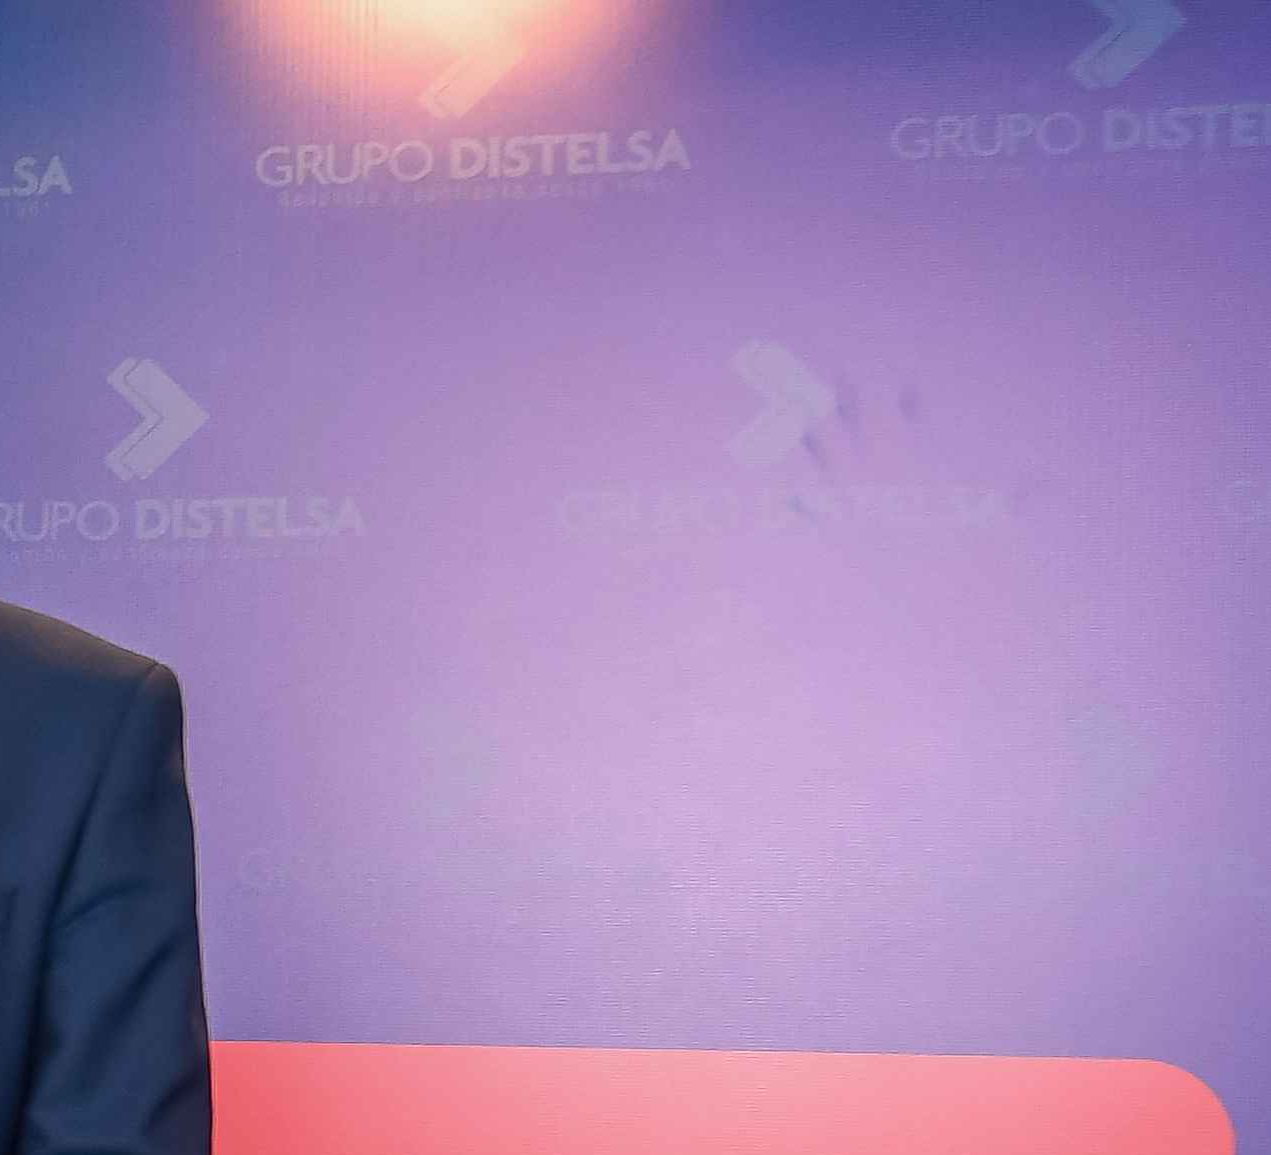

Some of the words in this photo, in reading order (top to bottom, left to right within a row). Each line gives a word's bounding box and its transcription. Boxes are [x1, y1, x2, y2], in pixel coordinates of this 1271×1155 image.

[255, 139, 433, 187] GRUPO
[449, 128, 690, 179] DISTELSA
[890, 110, 1084, 160] GRUPO
[1102, 103, 1271, 152] DISTE
[135, 497, 367, 541] DISTELSA
